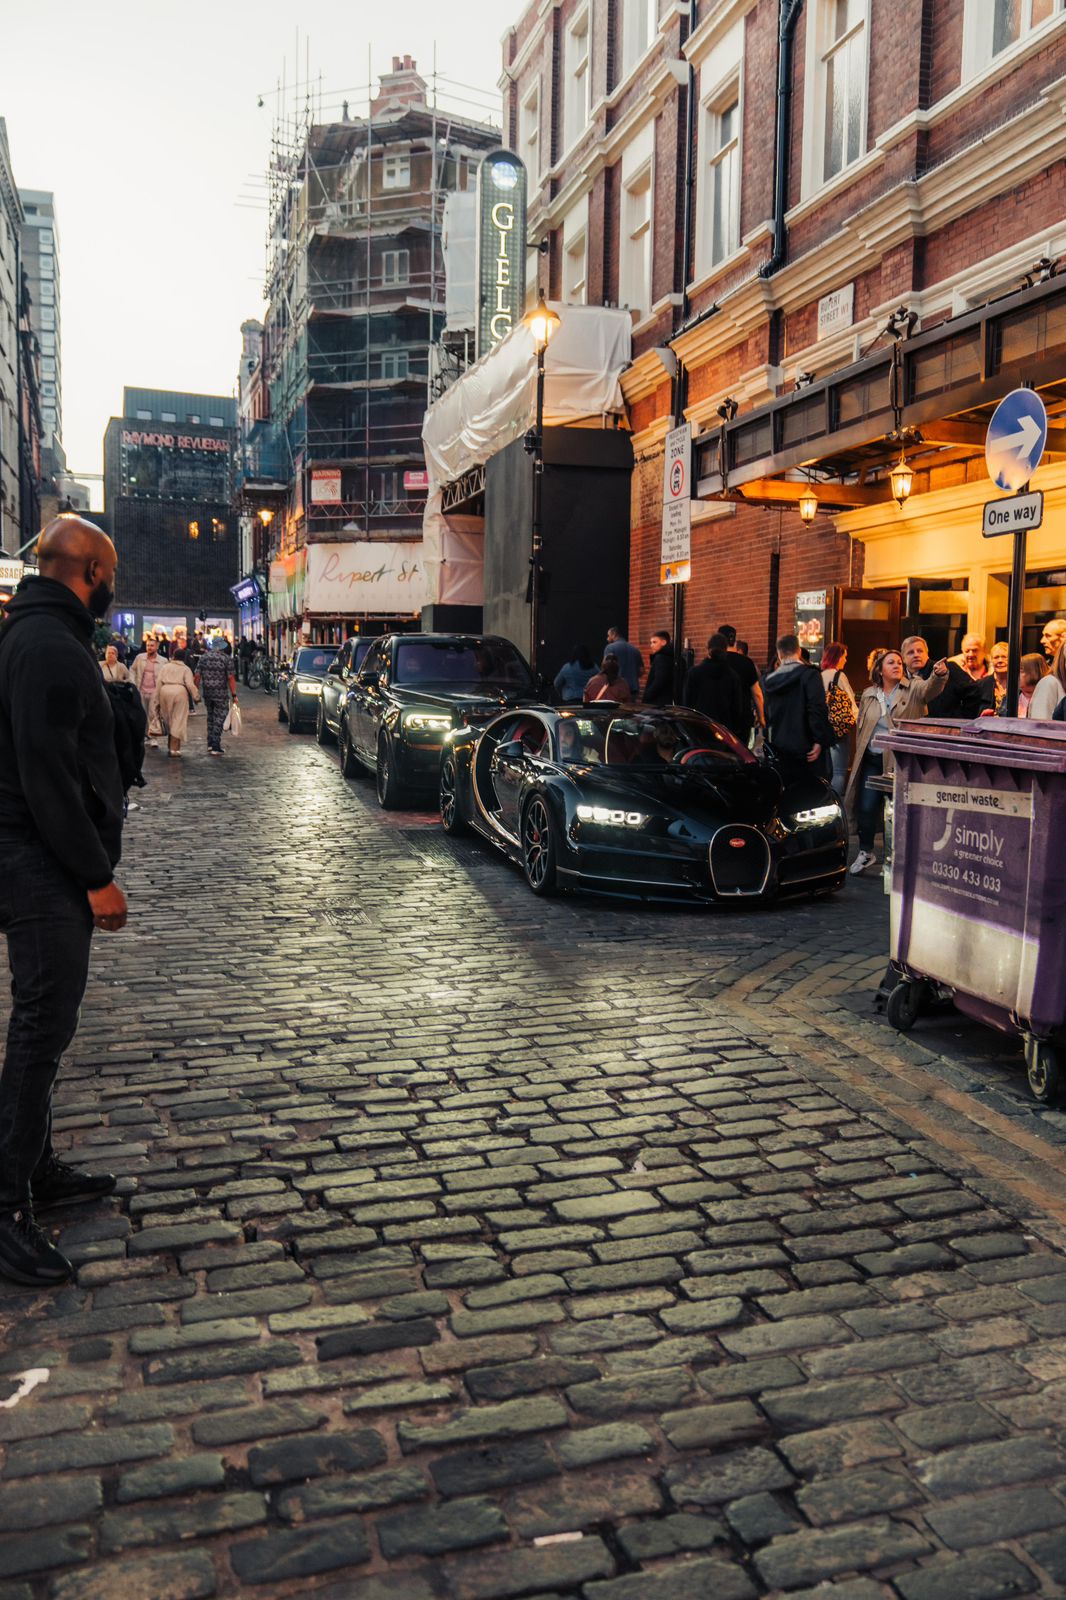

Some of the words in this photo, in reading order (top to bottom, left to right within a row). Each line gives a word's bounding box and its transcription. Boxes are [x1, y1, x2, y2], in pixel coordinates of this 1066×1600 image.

[820, 307, 839, 328] STREET
[122, 430, 175, 448] RAYMOND
[177, 435, 230, 452] REVUEBAR
[670, 444, 685, 459] ZONE
[988, 509, 1010, 526] One
[1013, 505, 1037, 521] way
[319, 553, 395, 588] Rupert
[936, 791, 969, 803] general
[971, 794, 999, 807] waste
[955, 824, 1004, 857] simply
[958, 850, 982, 861] greener
[983, 855, 1003, 868] choice
[932, 861, 960, 880] 03330
[962, 870, 980, 887] 433
[983, 875, 1001, 893] 033
